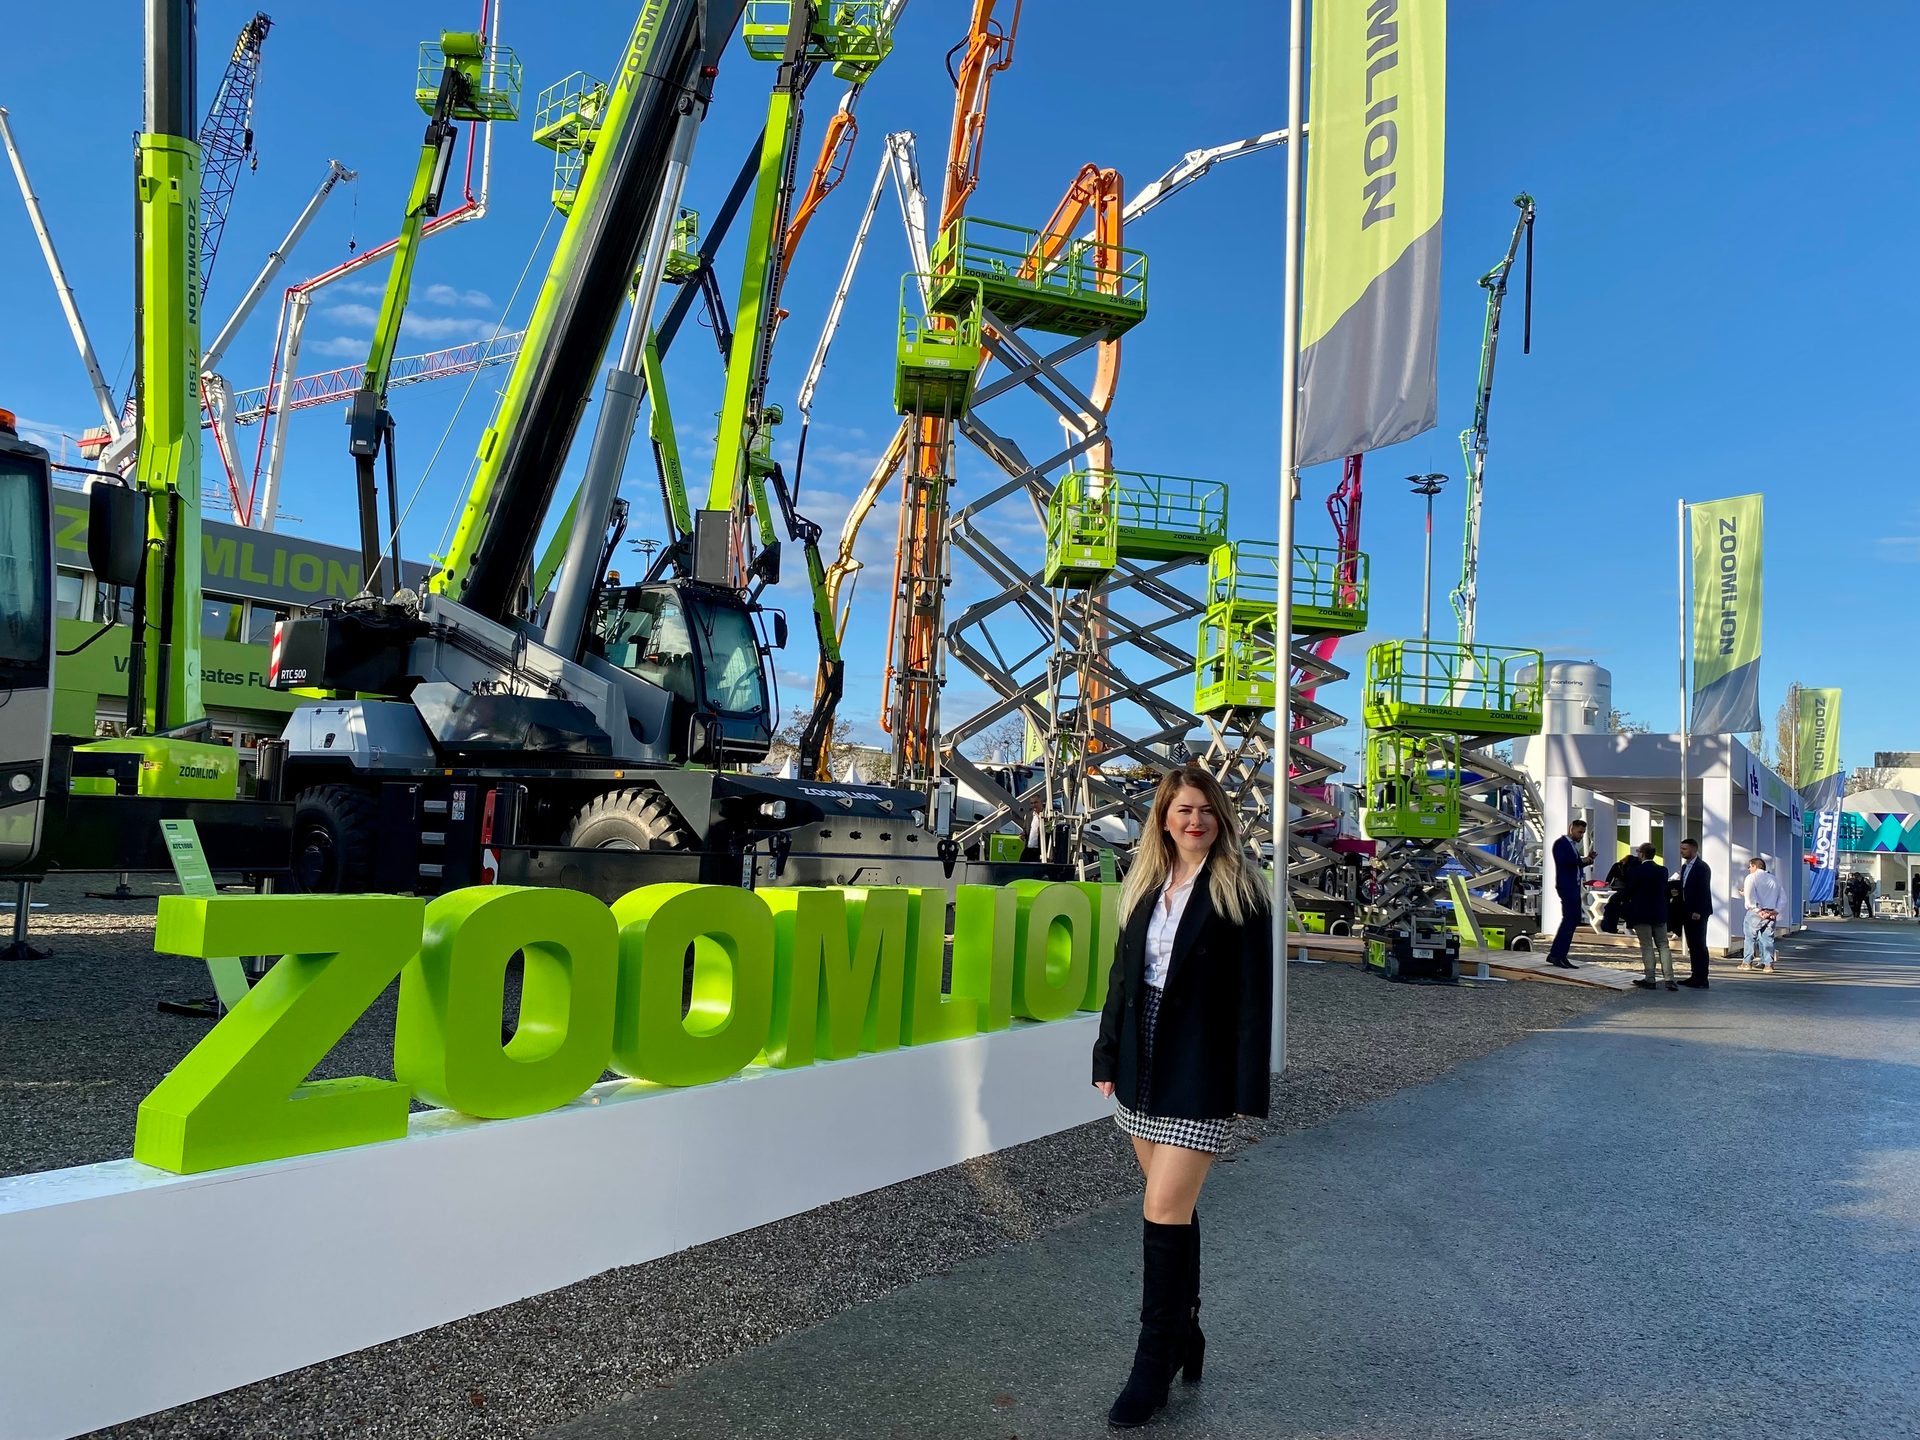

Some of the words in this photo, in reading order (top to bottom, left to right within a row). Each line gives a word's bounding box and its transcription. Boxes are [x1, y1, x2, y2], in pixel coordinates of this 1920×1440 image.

[188, 197, 196, 325] ZOOMLION
[964, 269, 1005, 283] ZOOMLION
[189, 348, 197, 398] ZT58J
[1173, 533, 1207, 543] ZOOMLION
[55, 504, 359, 599] ZMLION
[1719, 516, 1737, 656] ZOOMLION
[1318, 609, 1354, 618] ZOOMLION
[281, 669, 293, 680] RTC
[294, 669, 307, 679] 500
[1490, 712, 1528, 721] ZOOMLION
[1813, 698, 1826, 771] ZOOMLION
[179, 765, 219, 779] ZOOMLION
[797, 786, 883, 802] ZOOMLION
